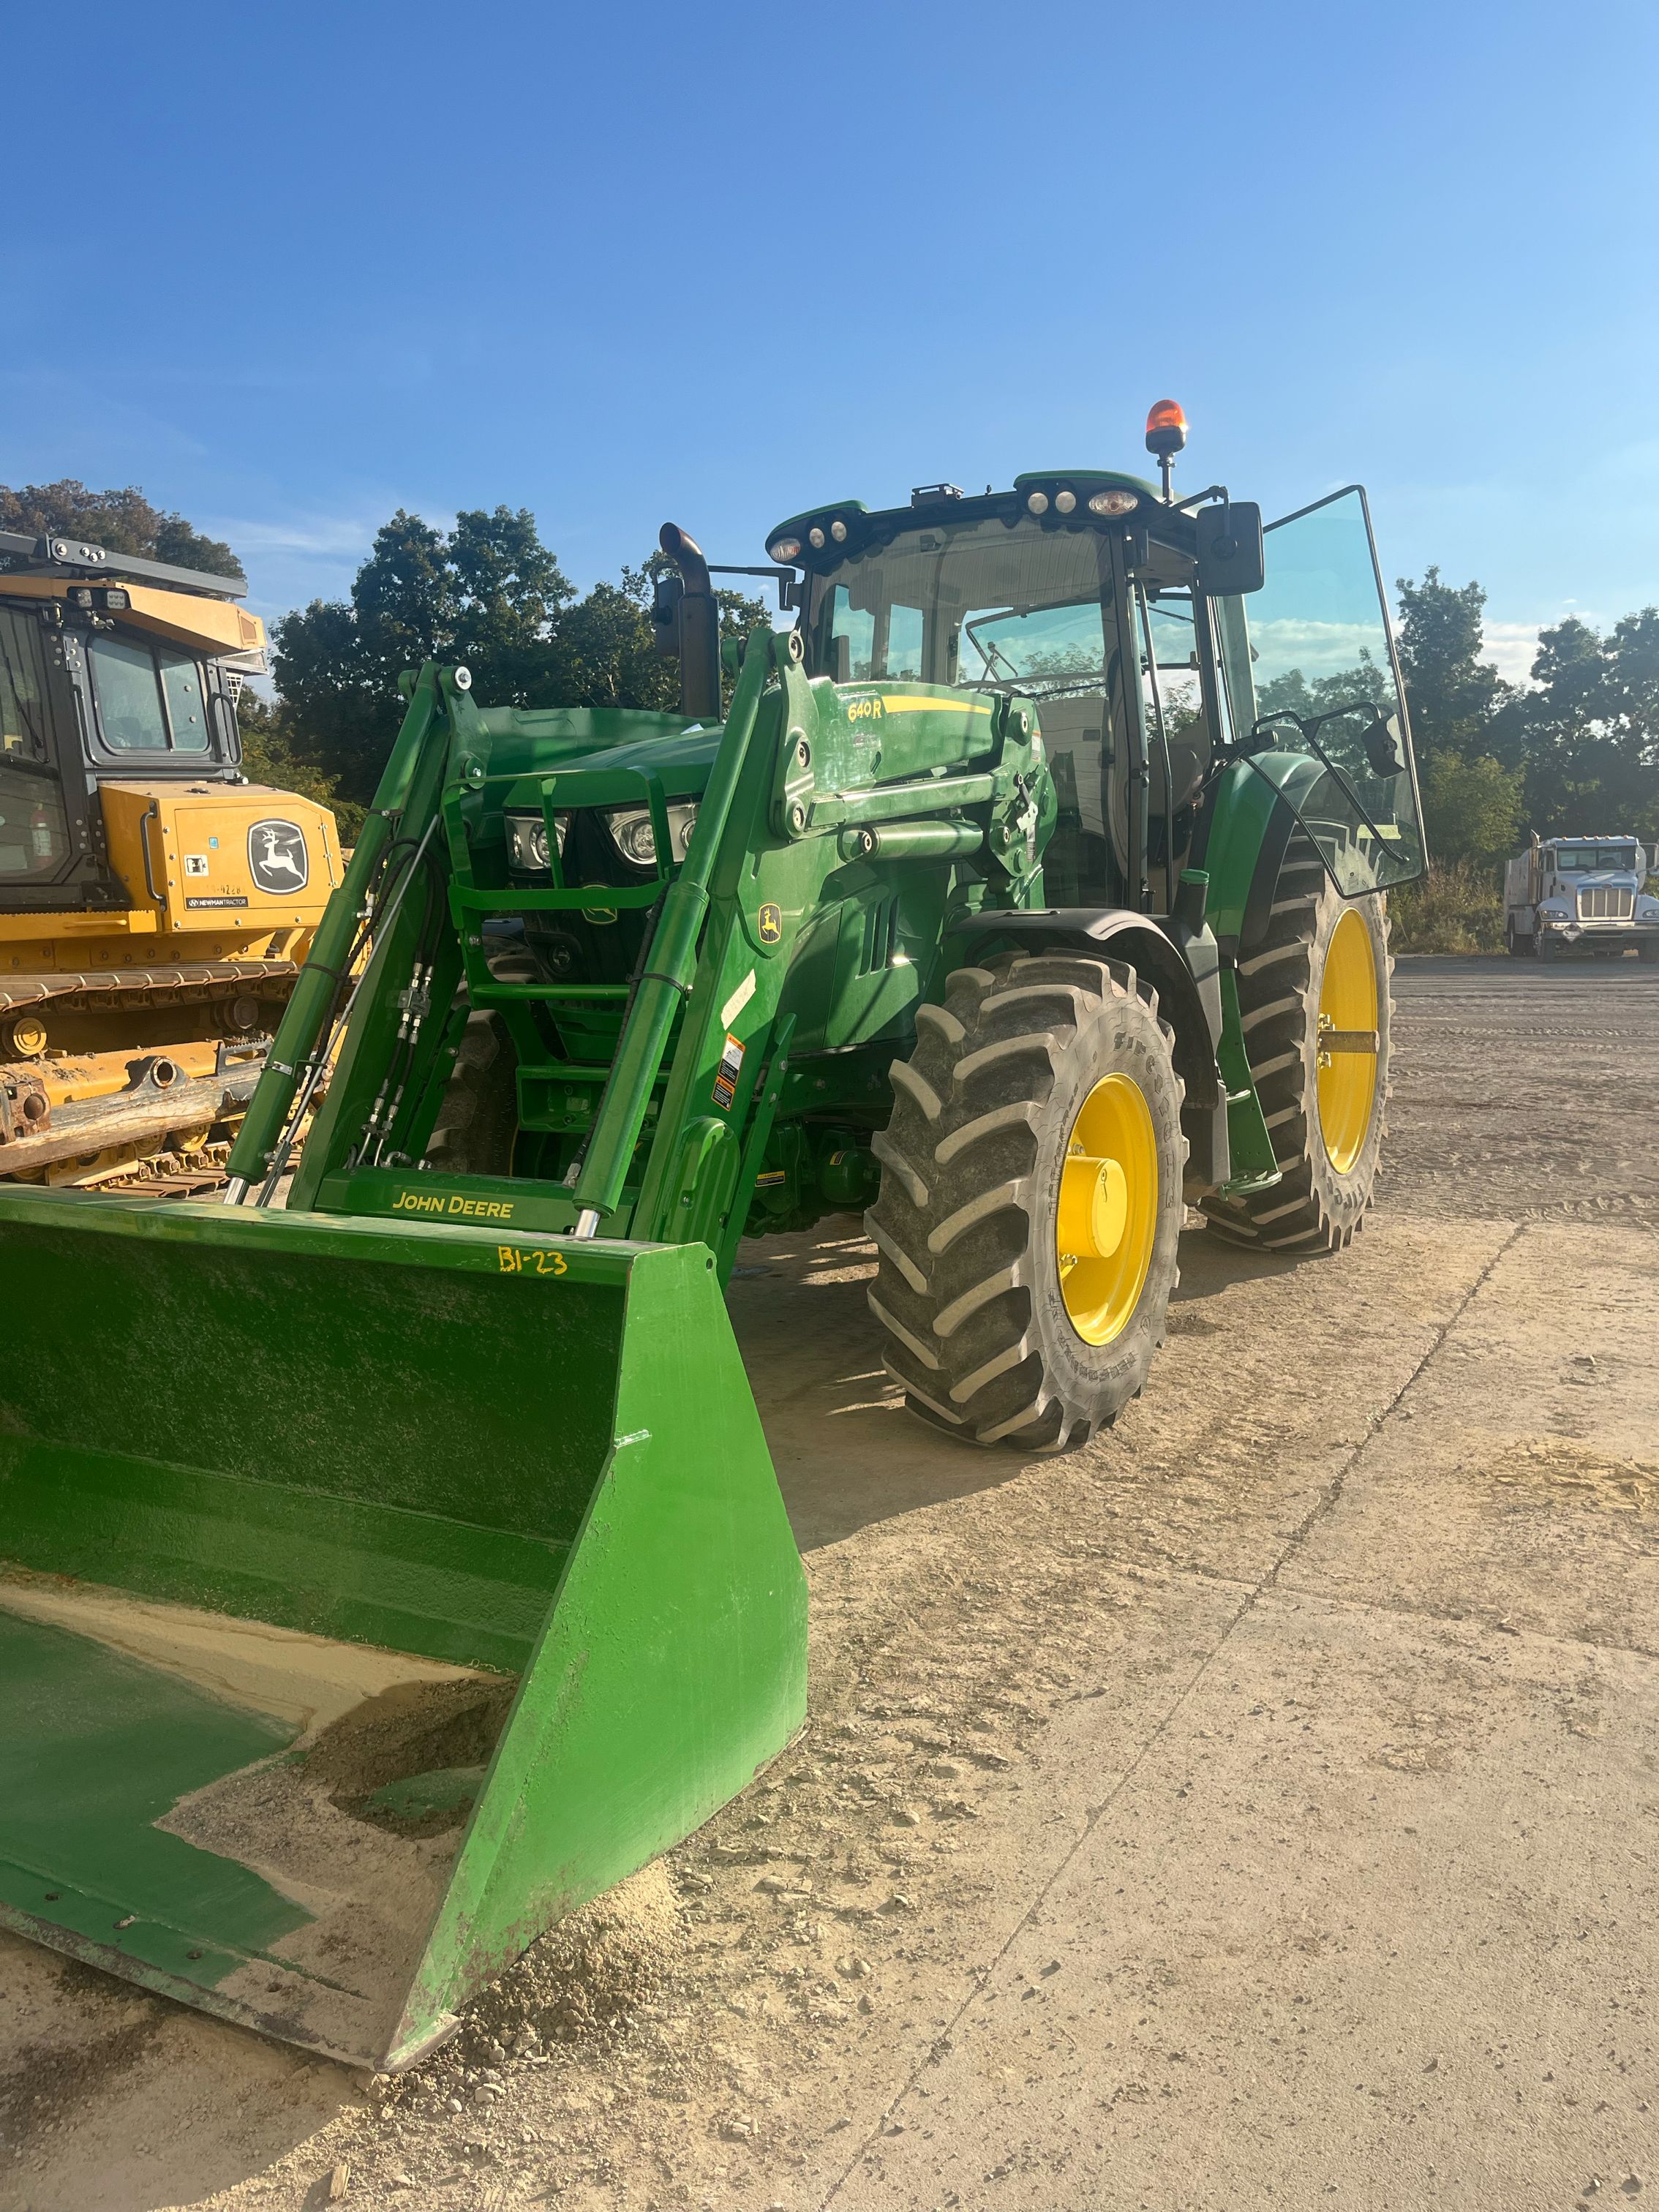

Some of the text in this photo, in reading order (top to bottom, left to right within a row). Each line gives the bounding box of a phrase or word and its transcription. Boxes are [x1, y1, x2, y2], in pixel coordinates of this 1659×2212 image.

[848, 699, 881, 723] 640R
[393, 1192, 514, 1219] JOHN DEERE
